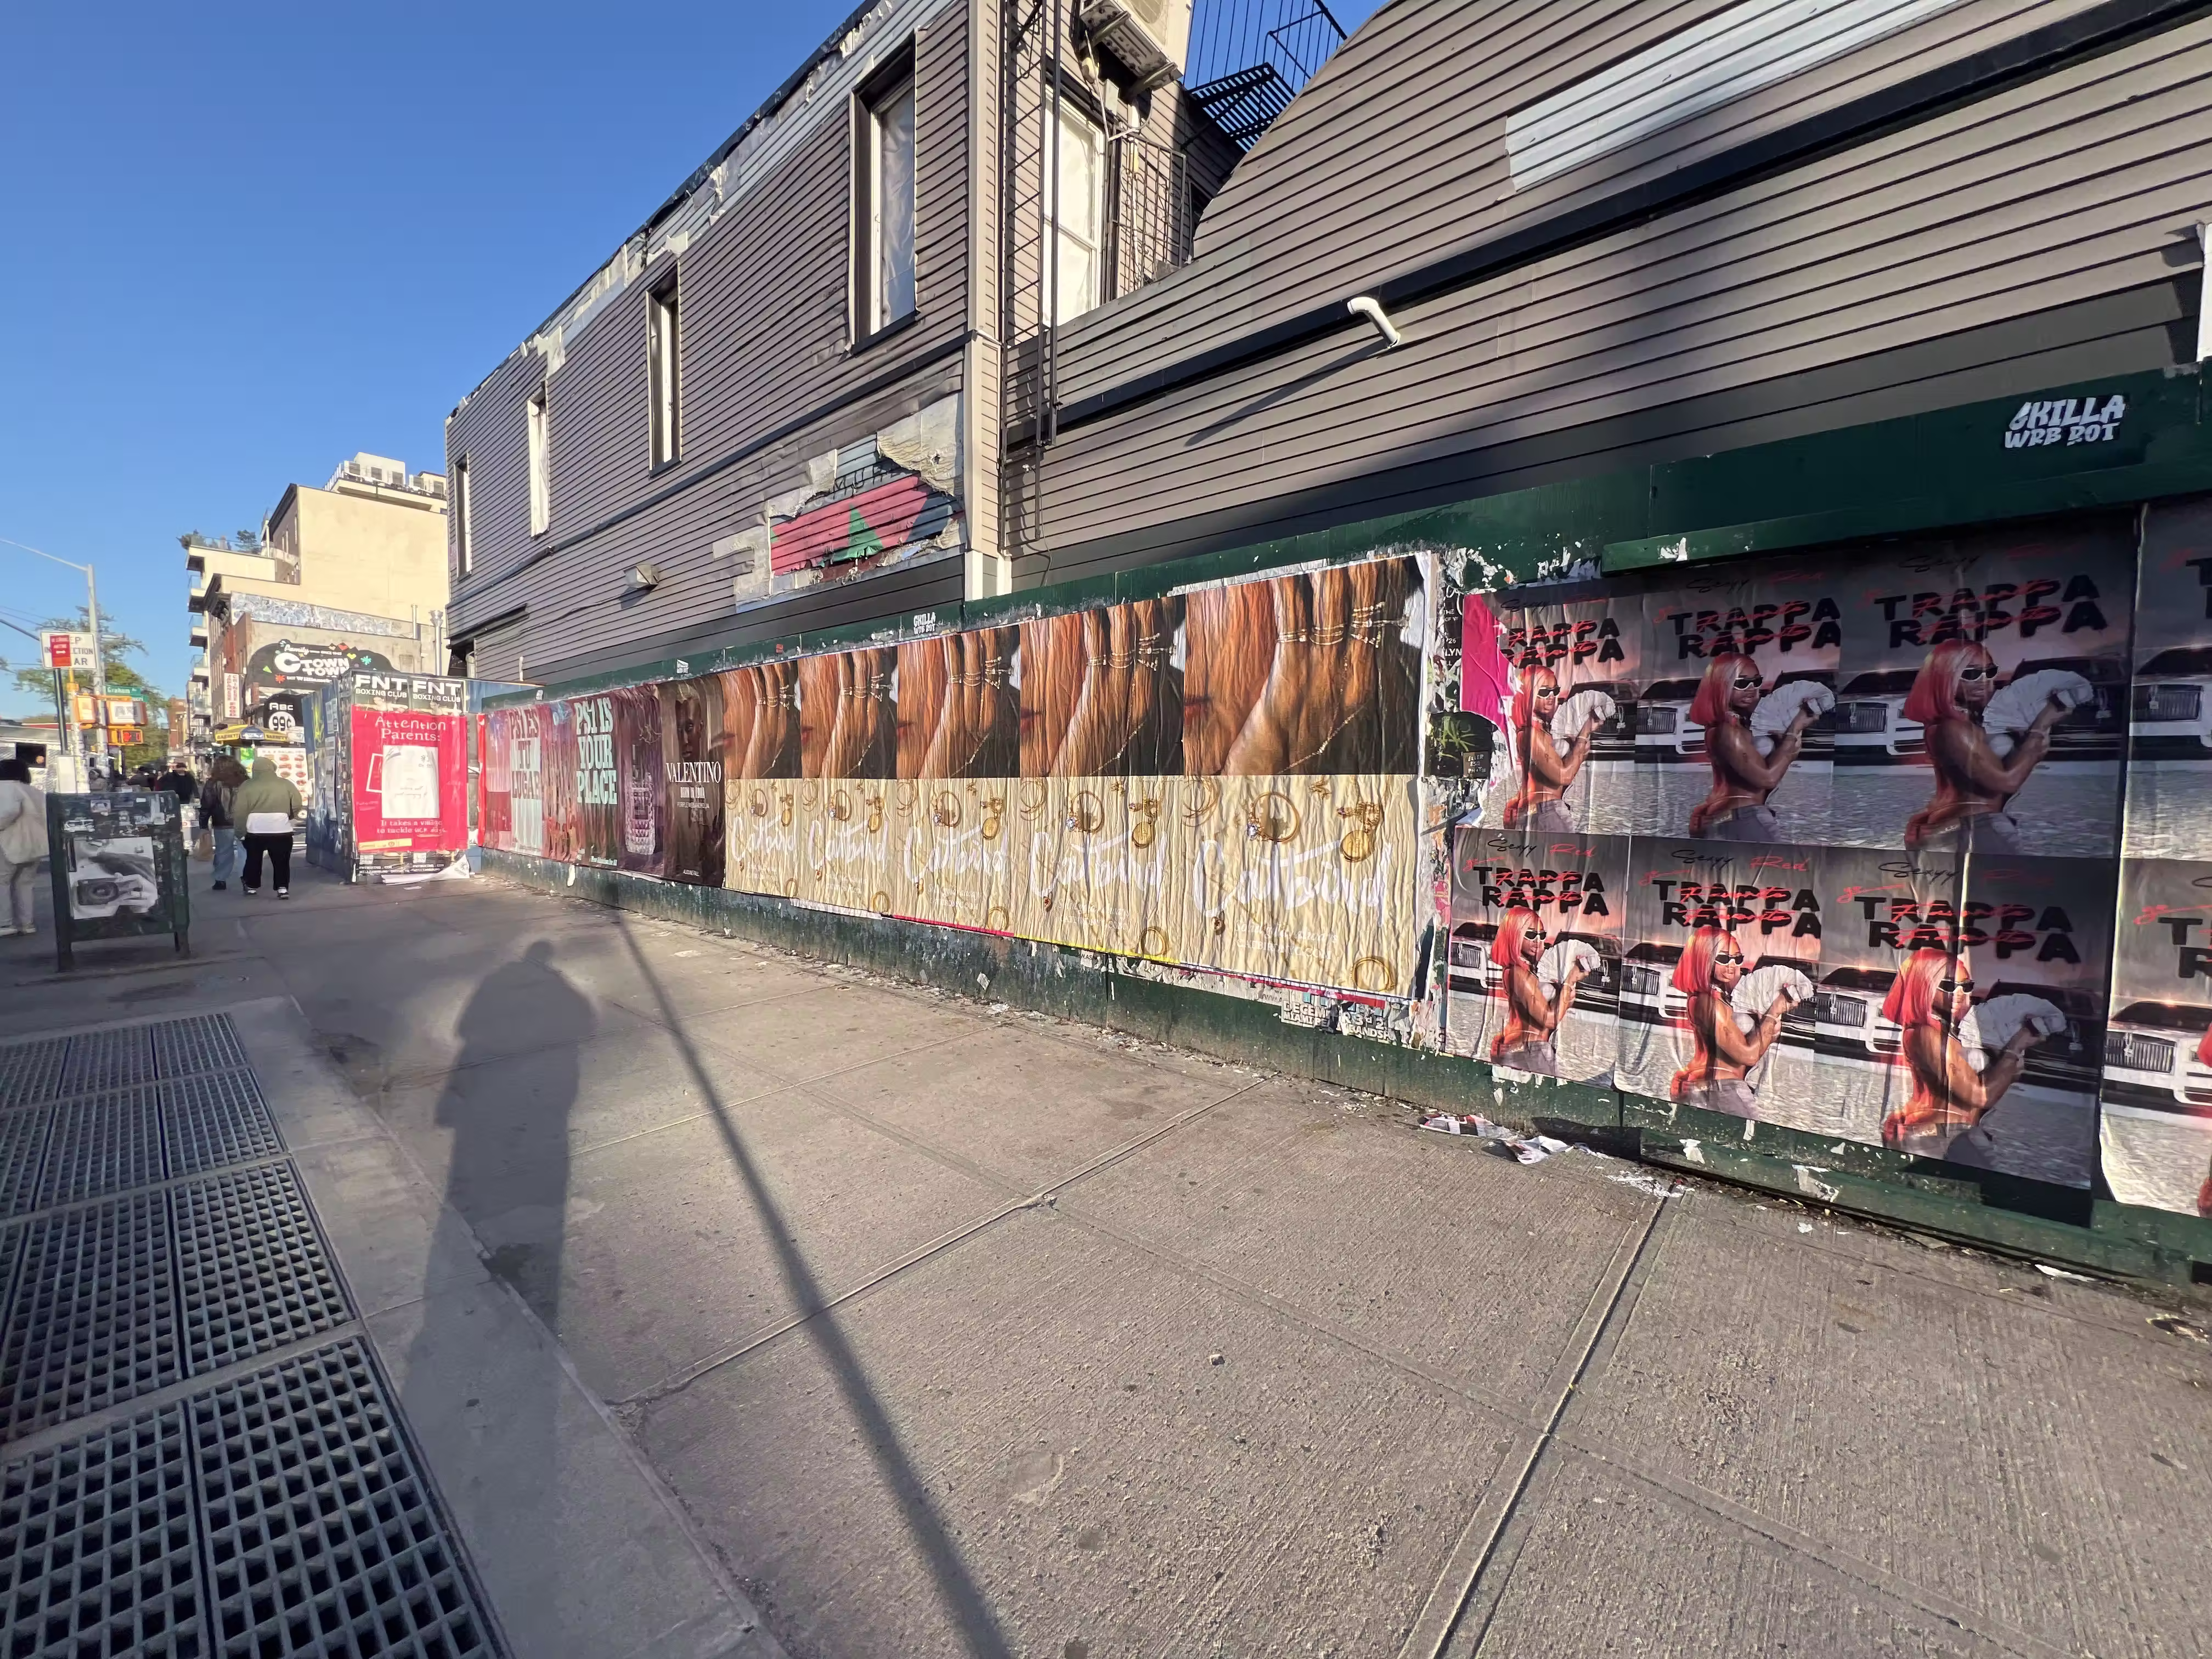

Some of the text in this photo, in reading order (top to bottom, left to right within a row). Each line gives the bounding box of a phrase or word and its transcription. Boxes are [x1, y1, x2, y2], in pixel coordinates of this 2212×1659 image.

[1667, 597, 1841, 635] TRAPPA
[1874, 574, 2100, 622] TRAPPA
[1508, 618, 1620, 647] RAPPA
[1678, 621, 1842, 659] RAPPA
[1889, 600, 2108, 648] RAPPA
[356, 674, 407, 691] FNT
[413, 680, 461, 696] FNT
[598, 697, 613, 732] IS
[578, 733, 613, 770] YOUR
[576, 769, 618, 805] PLACE
[666, 760, 722, 783] VALENTINO
[731, 815, 797, 862] Catbird
[808, 819, 888, 873] Catbird
[903, 825, 1008, 888] Catbird
[1029, 830, 1168, 904] Catbird
[1193, 839, 1392, 927] Catbird
[1474, 866, 1605, 892] TRAPPA
[1482, 885, 1609, 916] RAPPA
[1651, 879, 1820, 911] TRAPPA
[1662, 901, 1821, 939] RAPPA
[1854, 896, 2074, 933] TRAPPA
[1867, 921, 2081, 964] RAPPA
